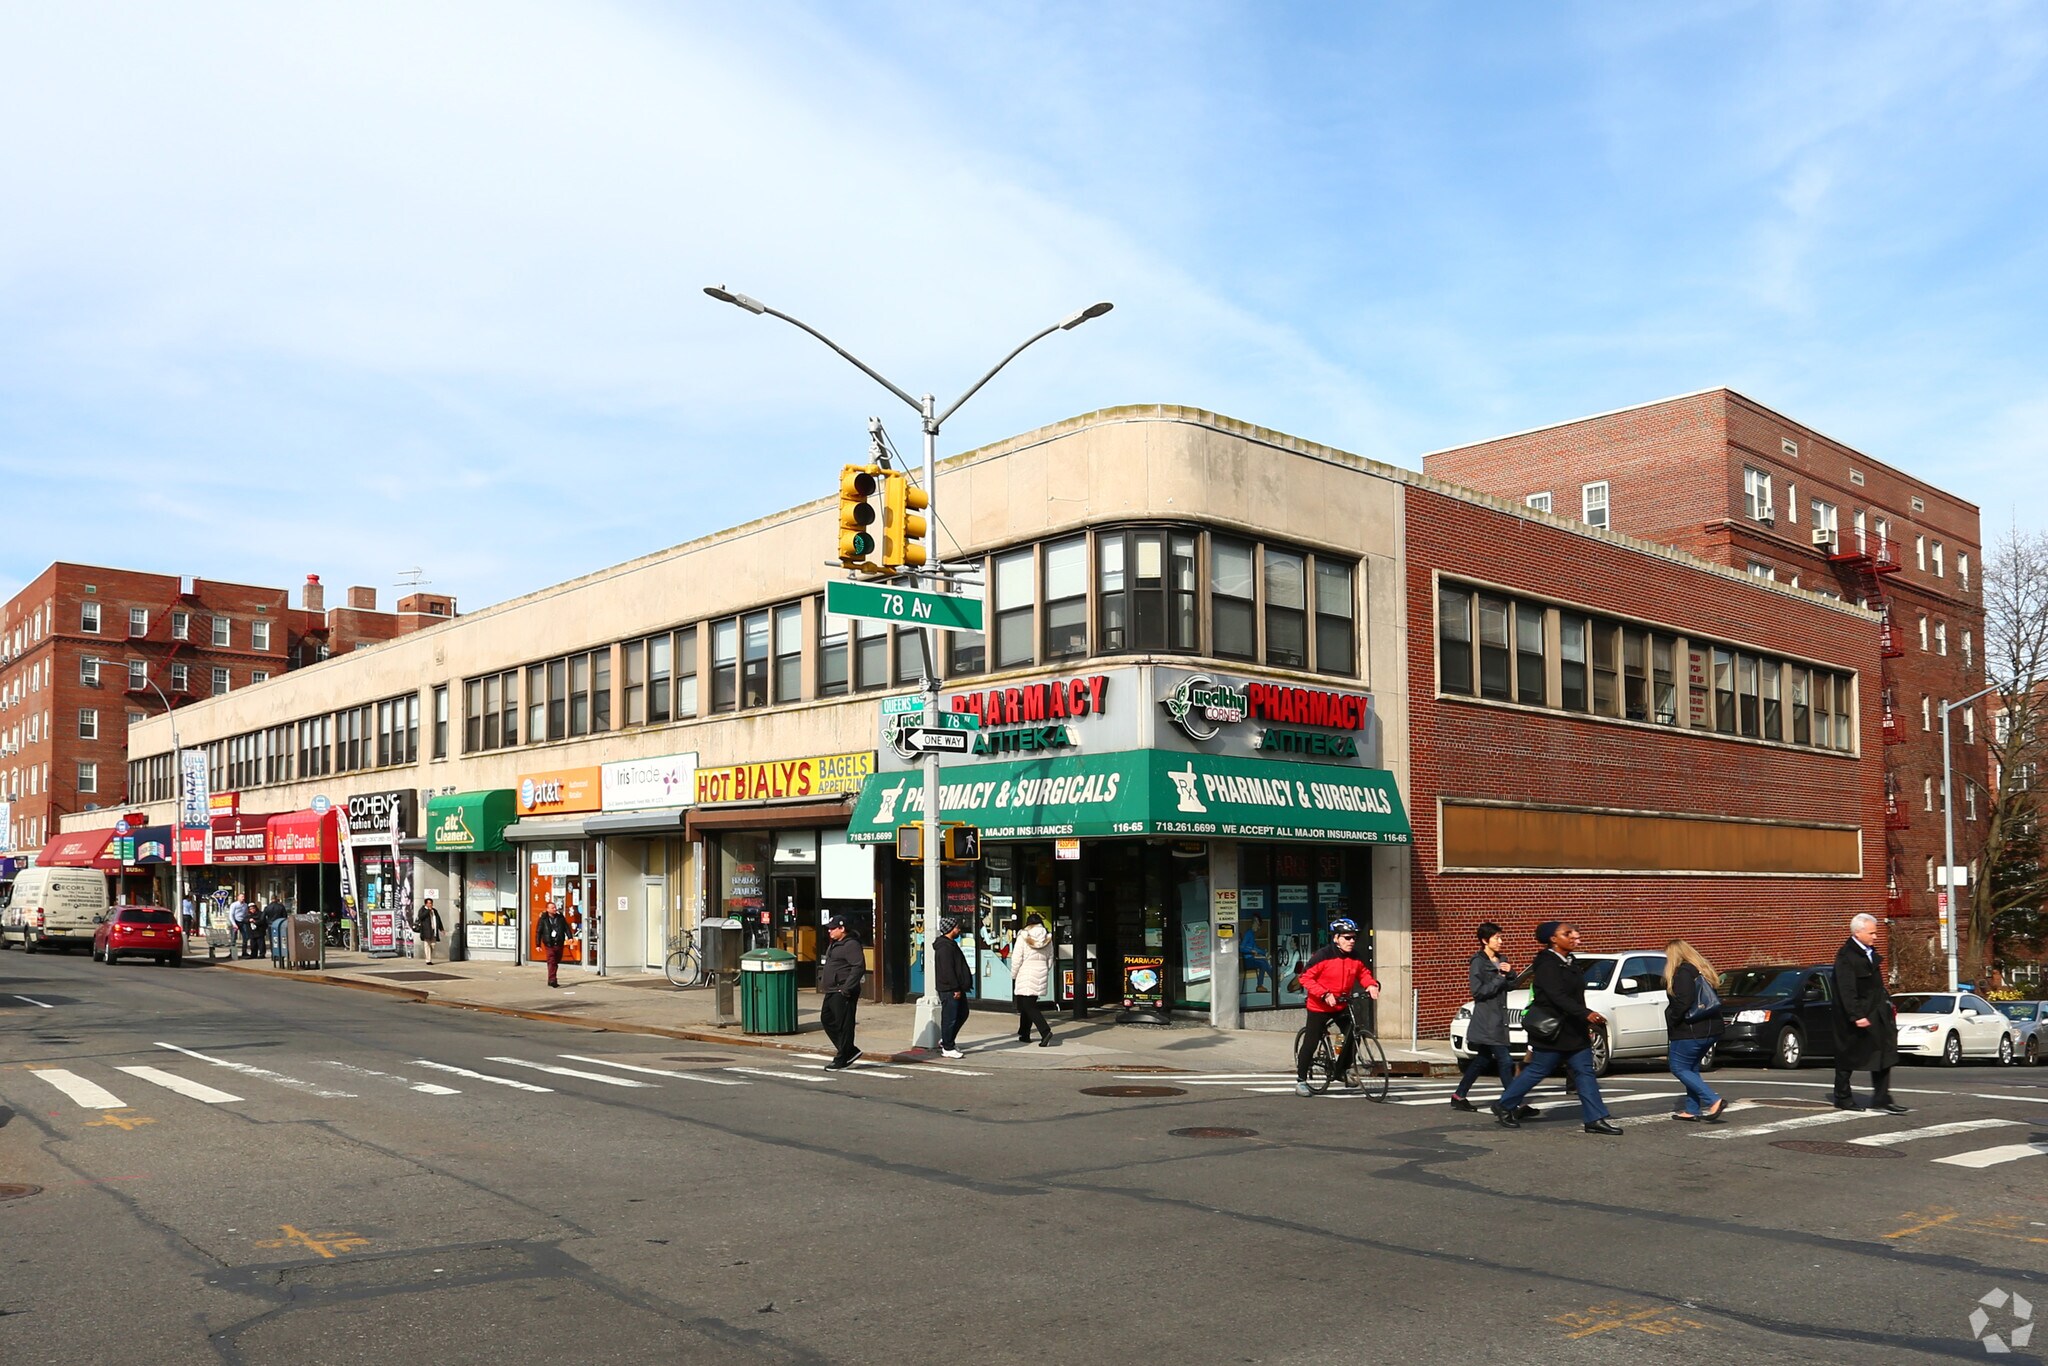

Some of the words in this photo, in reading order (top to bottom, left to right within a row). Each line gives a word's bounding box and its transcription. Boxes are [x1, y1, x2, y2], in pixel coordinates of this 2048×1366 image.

[881, 593, 904, 616] 78
[911, 597, 932, 619] Av
[884, 697, 912, 714] QUEENS
[952, 676, 1106, 727] PHARMACY
[1249, 682, 1368, 730] PHARMACY
[946, 714, 960, 728] 78
[1206, 707, 1241, 722] CORNER
[924, 736, 942, 745] ONE
[945, 736, 962, 746] WAY
[1261, 728, 1359, 757] АПТЕКА
[819, 756, 867, 778] BAGELS
[186, 772, 196, 810] PLAZA
[535, 778, 560, 802] at&t
[698, 773, 730, 802] HOT
[735, 762, 811, 800] BIALYS
[902, 782, 997, 812] PHRMACY
[995, 780, 1010, 808] &
[1014, 772, 1120, 806] SURGICALS
[1203, 774, 1295, 808] PHARMACY
[1296, 782, 1312, 808] &
[1311, 782, 1392, 814] SURGICALS
[184, 814, 209, 822] 100
[350, 816, 371, 830] Fashion
[436, 826, 468, 842] Cleaners
[850, 832, 892, 842] 718.261.6699
[986, 825, 1015, 836] MAJOR
[1016, 824, 1074, 835] INSURANCES
[1113, 822, 1144, 832] 116-65
[1156, 822, 1216, 832] 718.261.6699
[1222, 824, 1238, 834] WE
[1240, 826, 1274, 836] ACCEPT
[1277, 827, 1293, 836] ALL
[1295, 828, 1326, 838] MAJOR
[1327, 830, 1378, 840] INSURANCES
[1384, 834, 1407, 842] 116-65
[274, 836, 286, 853] King
[294, 834, 314, 849] Garden
[1216, 892, 1236, 900] YES
[372, 926, 392, 935] $499
